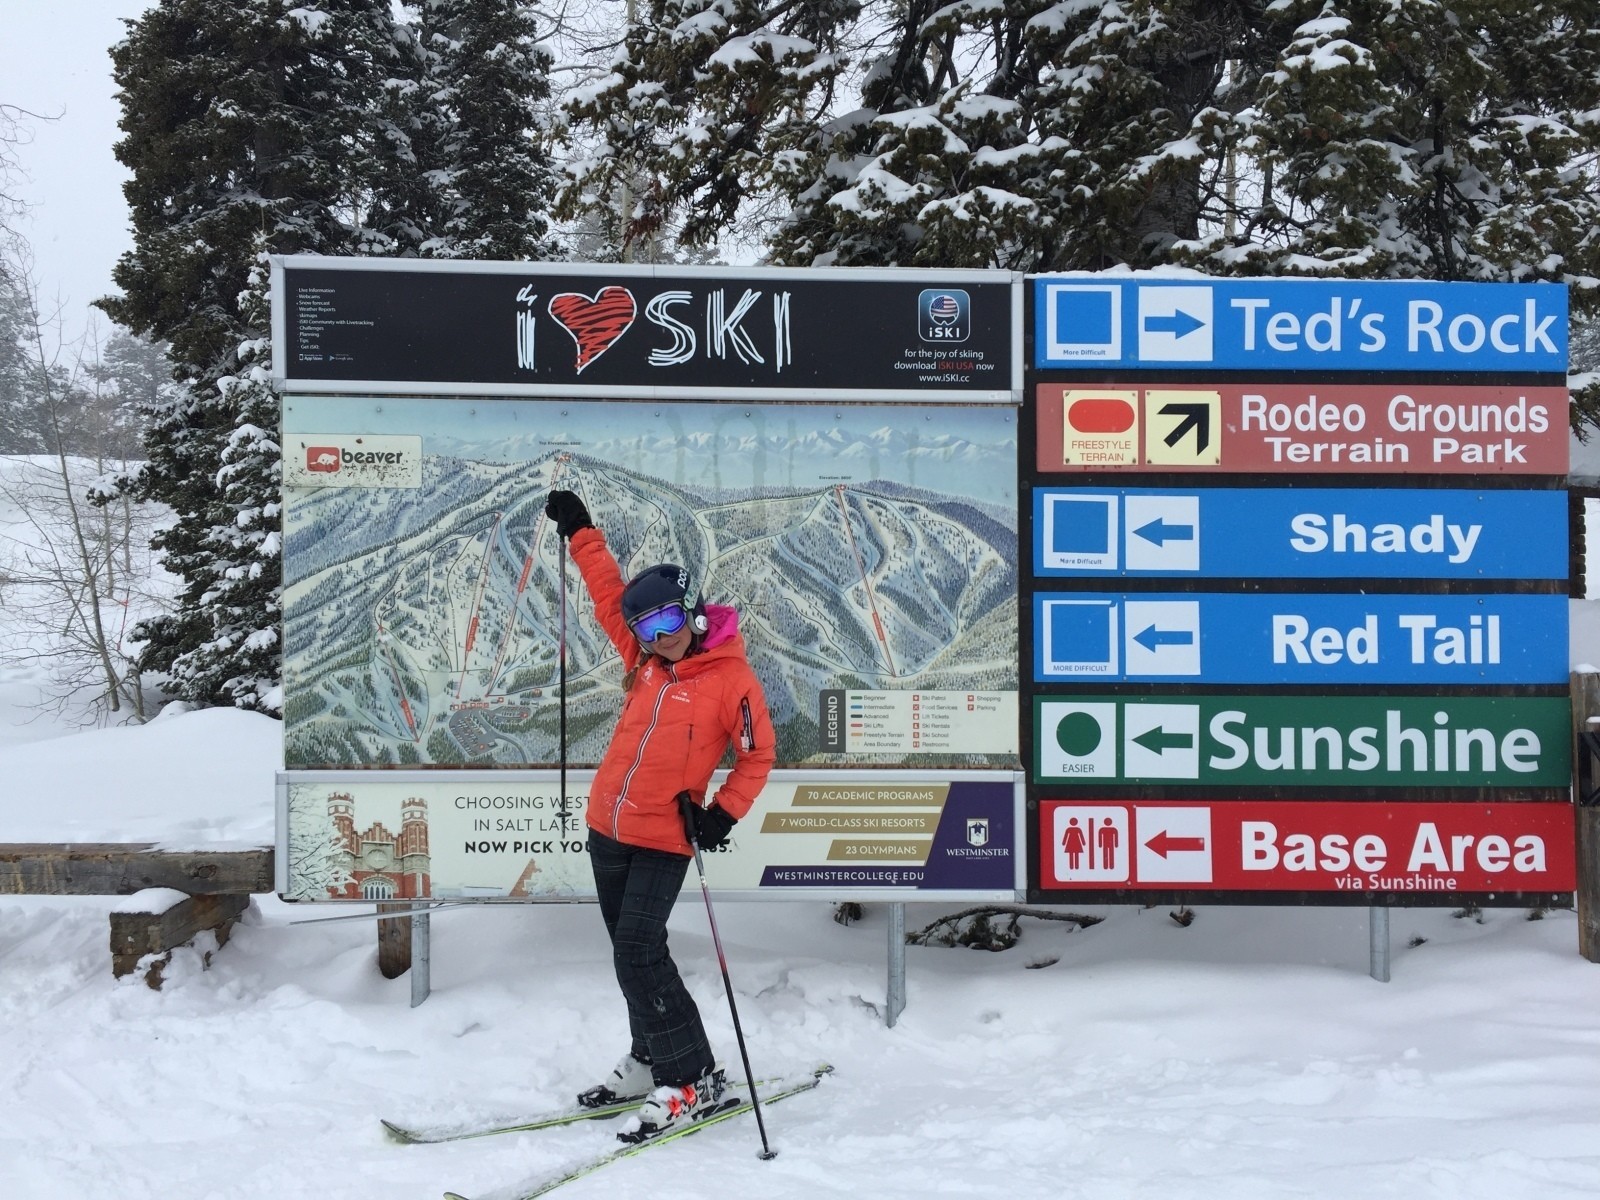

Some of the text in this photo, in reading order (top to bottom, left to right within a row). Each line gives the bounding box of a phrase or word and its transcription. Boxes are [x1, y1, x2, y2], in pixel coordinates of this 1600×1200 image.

[645, 288, 792, 373] SKI
[1231, 297, 1559, 353] Ted's Rock
[929, 327, 960, 338] iSKI
[904, 349, 984, 360] for the joy of skiing
[894, 361, 936, 370] download
[956, 362, 974, 370] USA
[919, 374, 970, 382] www.iSKI.cc
[1242, 395, 1549, 433] Rodeo Grounds
[1071, 440, 1131, 450] FREESTYLE
[1264, 437, 1527, 463] Terrain Park
[342, 448, 403, 464] beaver
[1080, 453, 1124, 462] TERRAIN
[1289, 514, 1483, 564] Shady
[1272, 614, 1500, 665] Red Tail
[828, 696, 838, 745] LEGEND
[1209, 710, 1541, 773] Sunshine
[1062, 764, 1095, 773] EASIER
[808, 791, 934, 800] 70 ACADEMIC PROGRAMS
[455, 796, 590, 809] CHOOSING WEST
[474, 819, 490, 831] IN
[496, 818, 534, 831] SALT
[540, 818, 580, 831] LAKE
[780, 818, 925, 827] 7 WORLD-CLASS SKI RESORTS
[465, 841, 590, 854] NOW PICK YO
[845, 846, 917, 855] 23 OLYMPIANS
[947, 848, 1009, 856] WESTMINSTER
[1241, 821, 1547, 873] Base Area
[774, 872, 924, 881] WESTMINSTERCOLLEGE.EDU
[1335, 874, 1457, 890] via Sunshine
